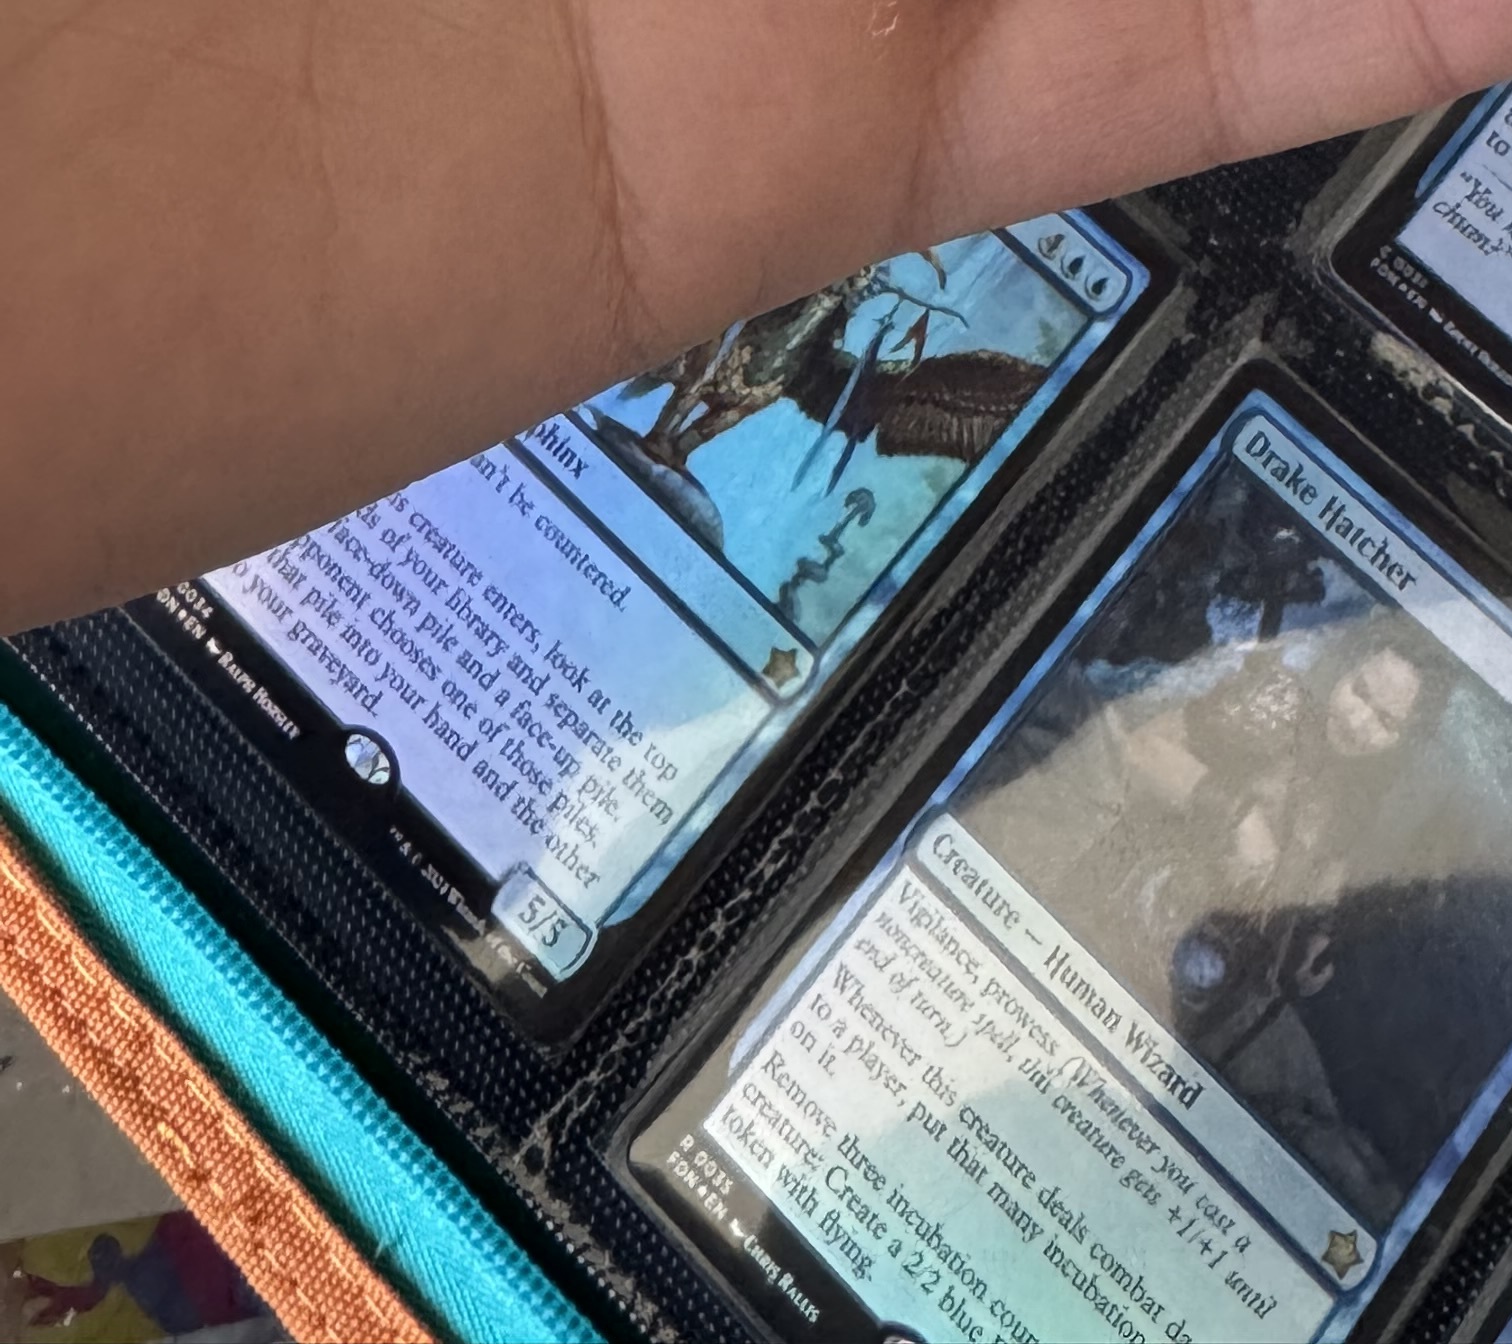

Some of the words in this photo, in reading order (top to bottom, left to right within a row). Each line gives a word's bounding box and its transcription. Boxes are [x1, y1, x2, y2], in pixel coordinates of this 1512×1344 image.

[1240, 427, 1326, 512] Drake
[1314, 492, 1424, 600] Hatcher
[514, 892, 569, 953] 5/5
[926, 826, 1027, 935] Creature
[1039, 941, 1129, 1039] Human
[1115, 1018, 1205, 1117] Wizard
